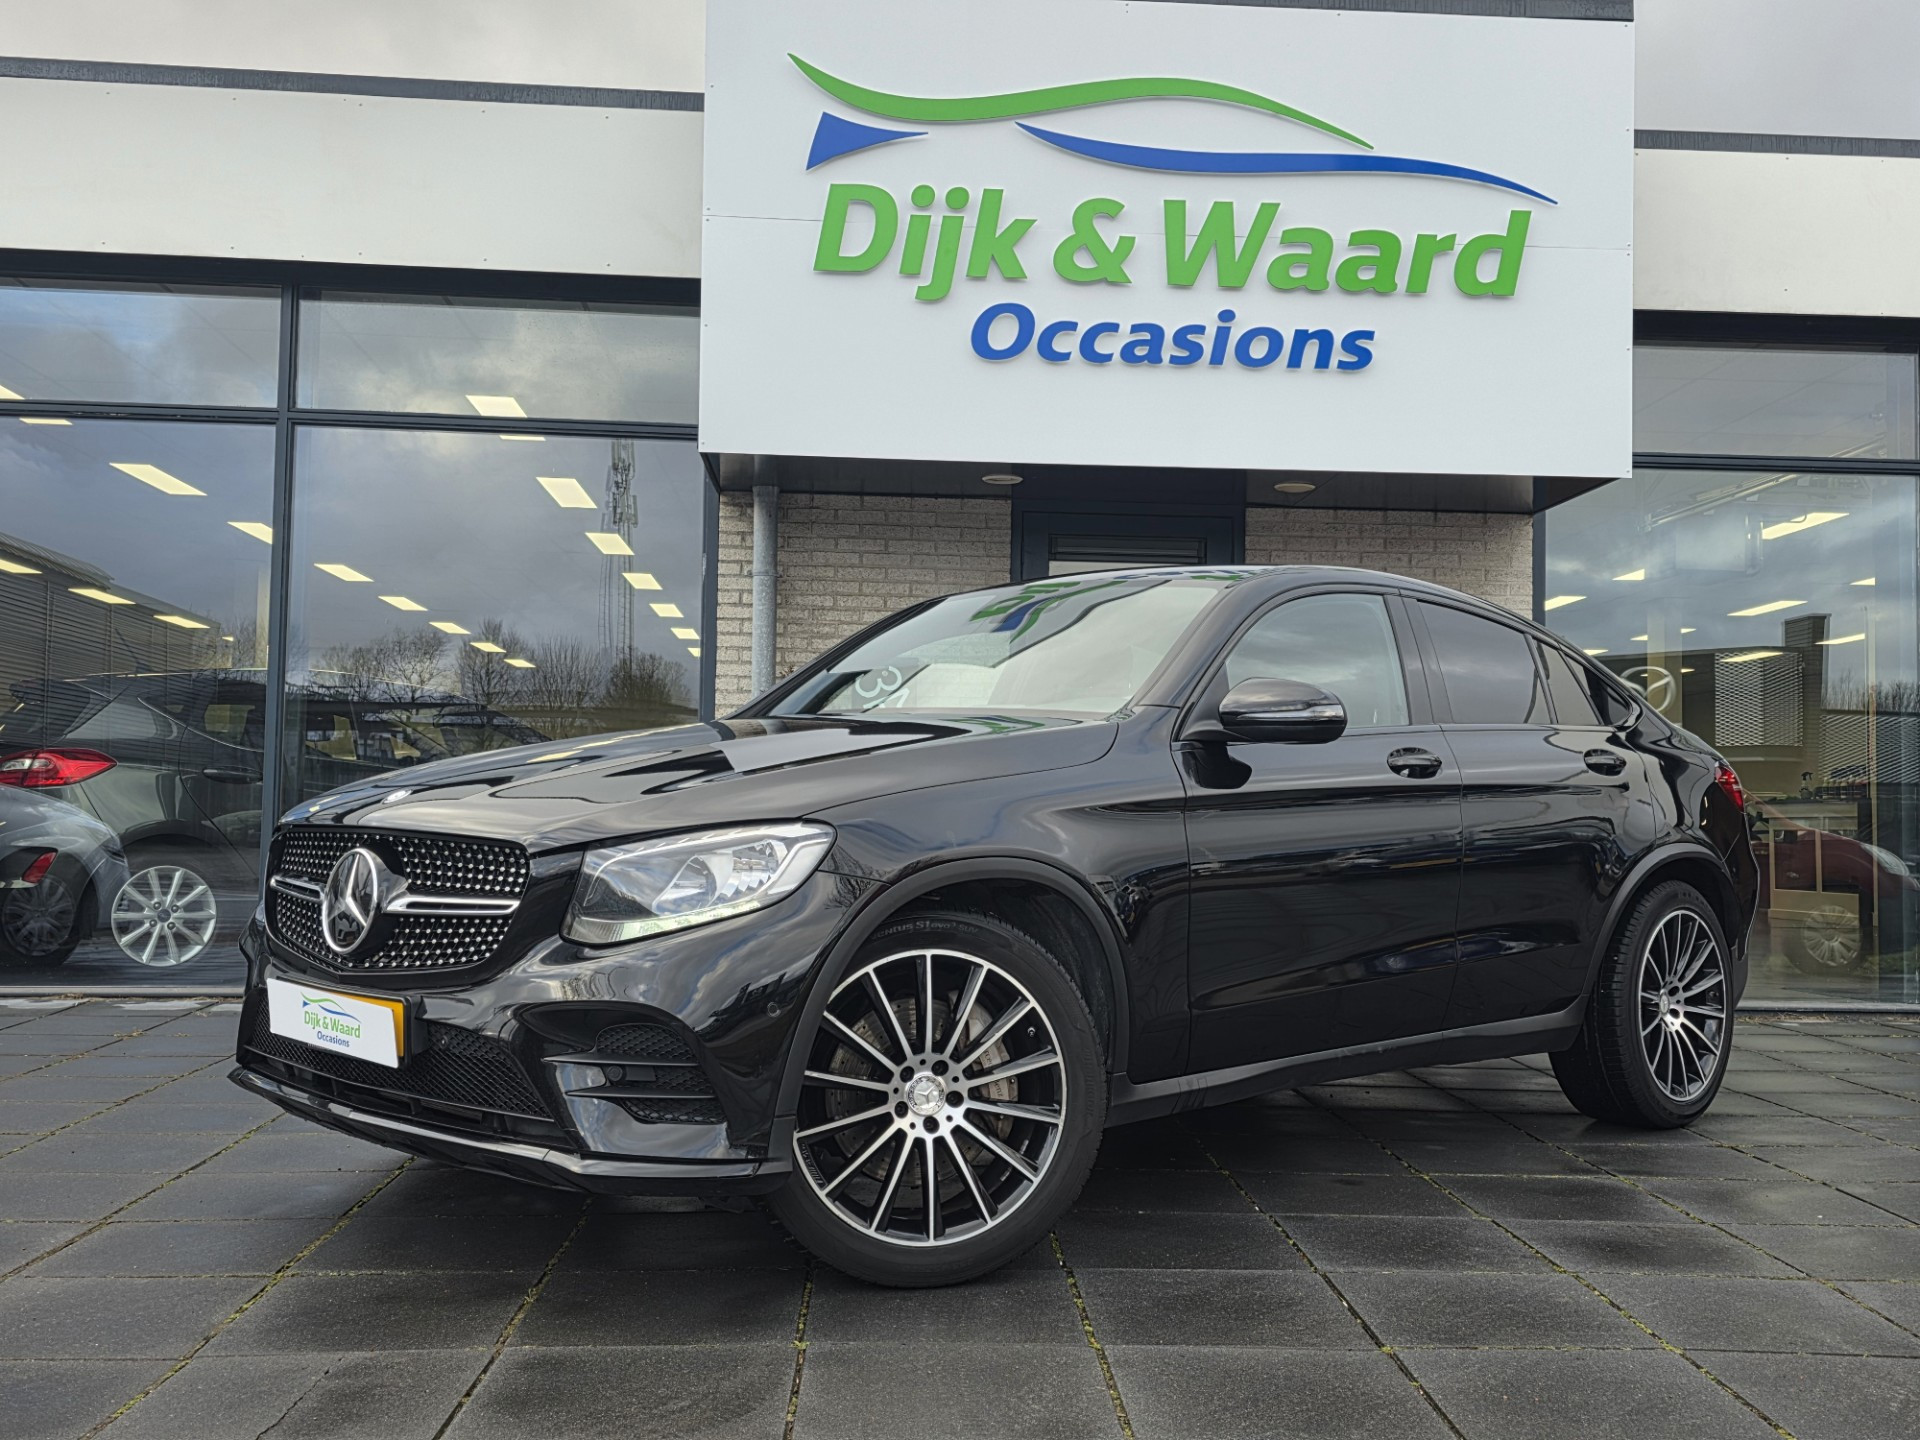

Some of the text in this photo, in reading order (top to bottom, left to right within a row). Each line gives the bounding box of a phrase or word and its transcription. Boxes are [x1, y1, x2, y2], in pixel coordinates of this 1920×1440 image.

[814, 183, 1532, 302] Dijk & Waard
[970, 302, 1376, 372] Occasions
[304, 1010, 361, 1039] Dijk & Waard
[316, 1030, 350, 1048] Occasions
